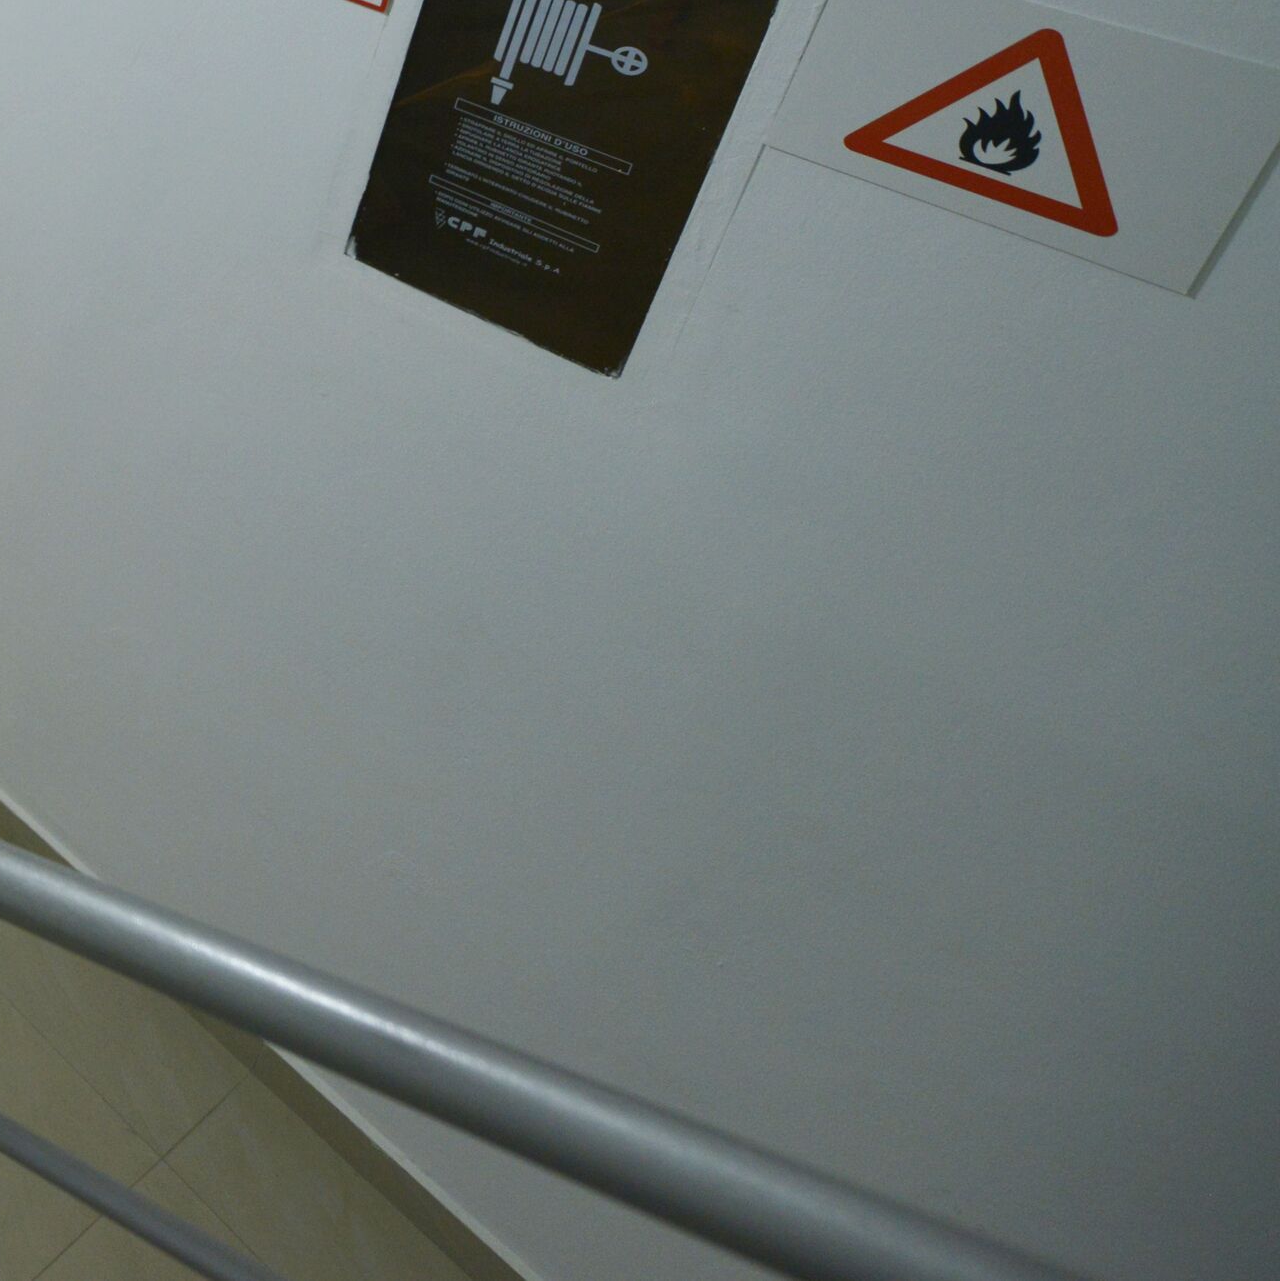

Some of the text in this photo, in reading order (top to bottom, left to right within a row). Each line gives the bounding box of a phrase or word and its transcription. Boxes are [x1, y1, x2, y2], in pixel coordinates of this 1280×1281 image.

[492, 114, 589, 156] ISTRUZIONI D'USO
[445, 213, 488, 241] CPF
[487, 237, 533, 263] Industriale
